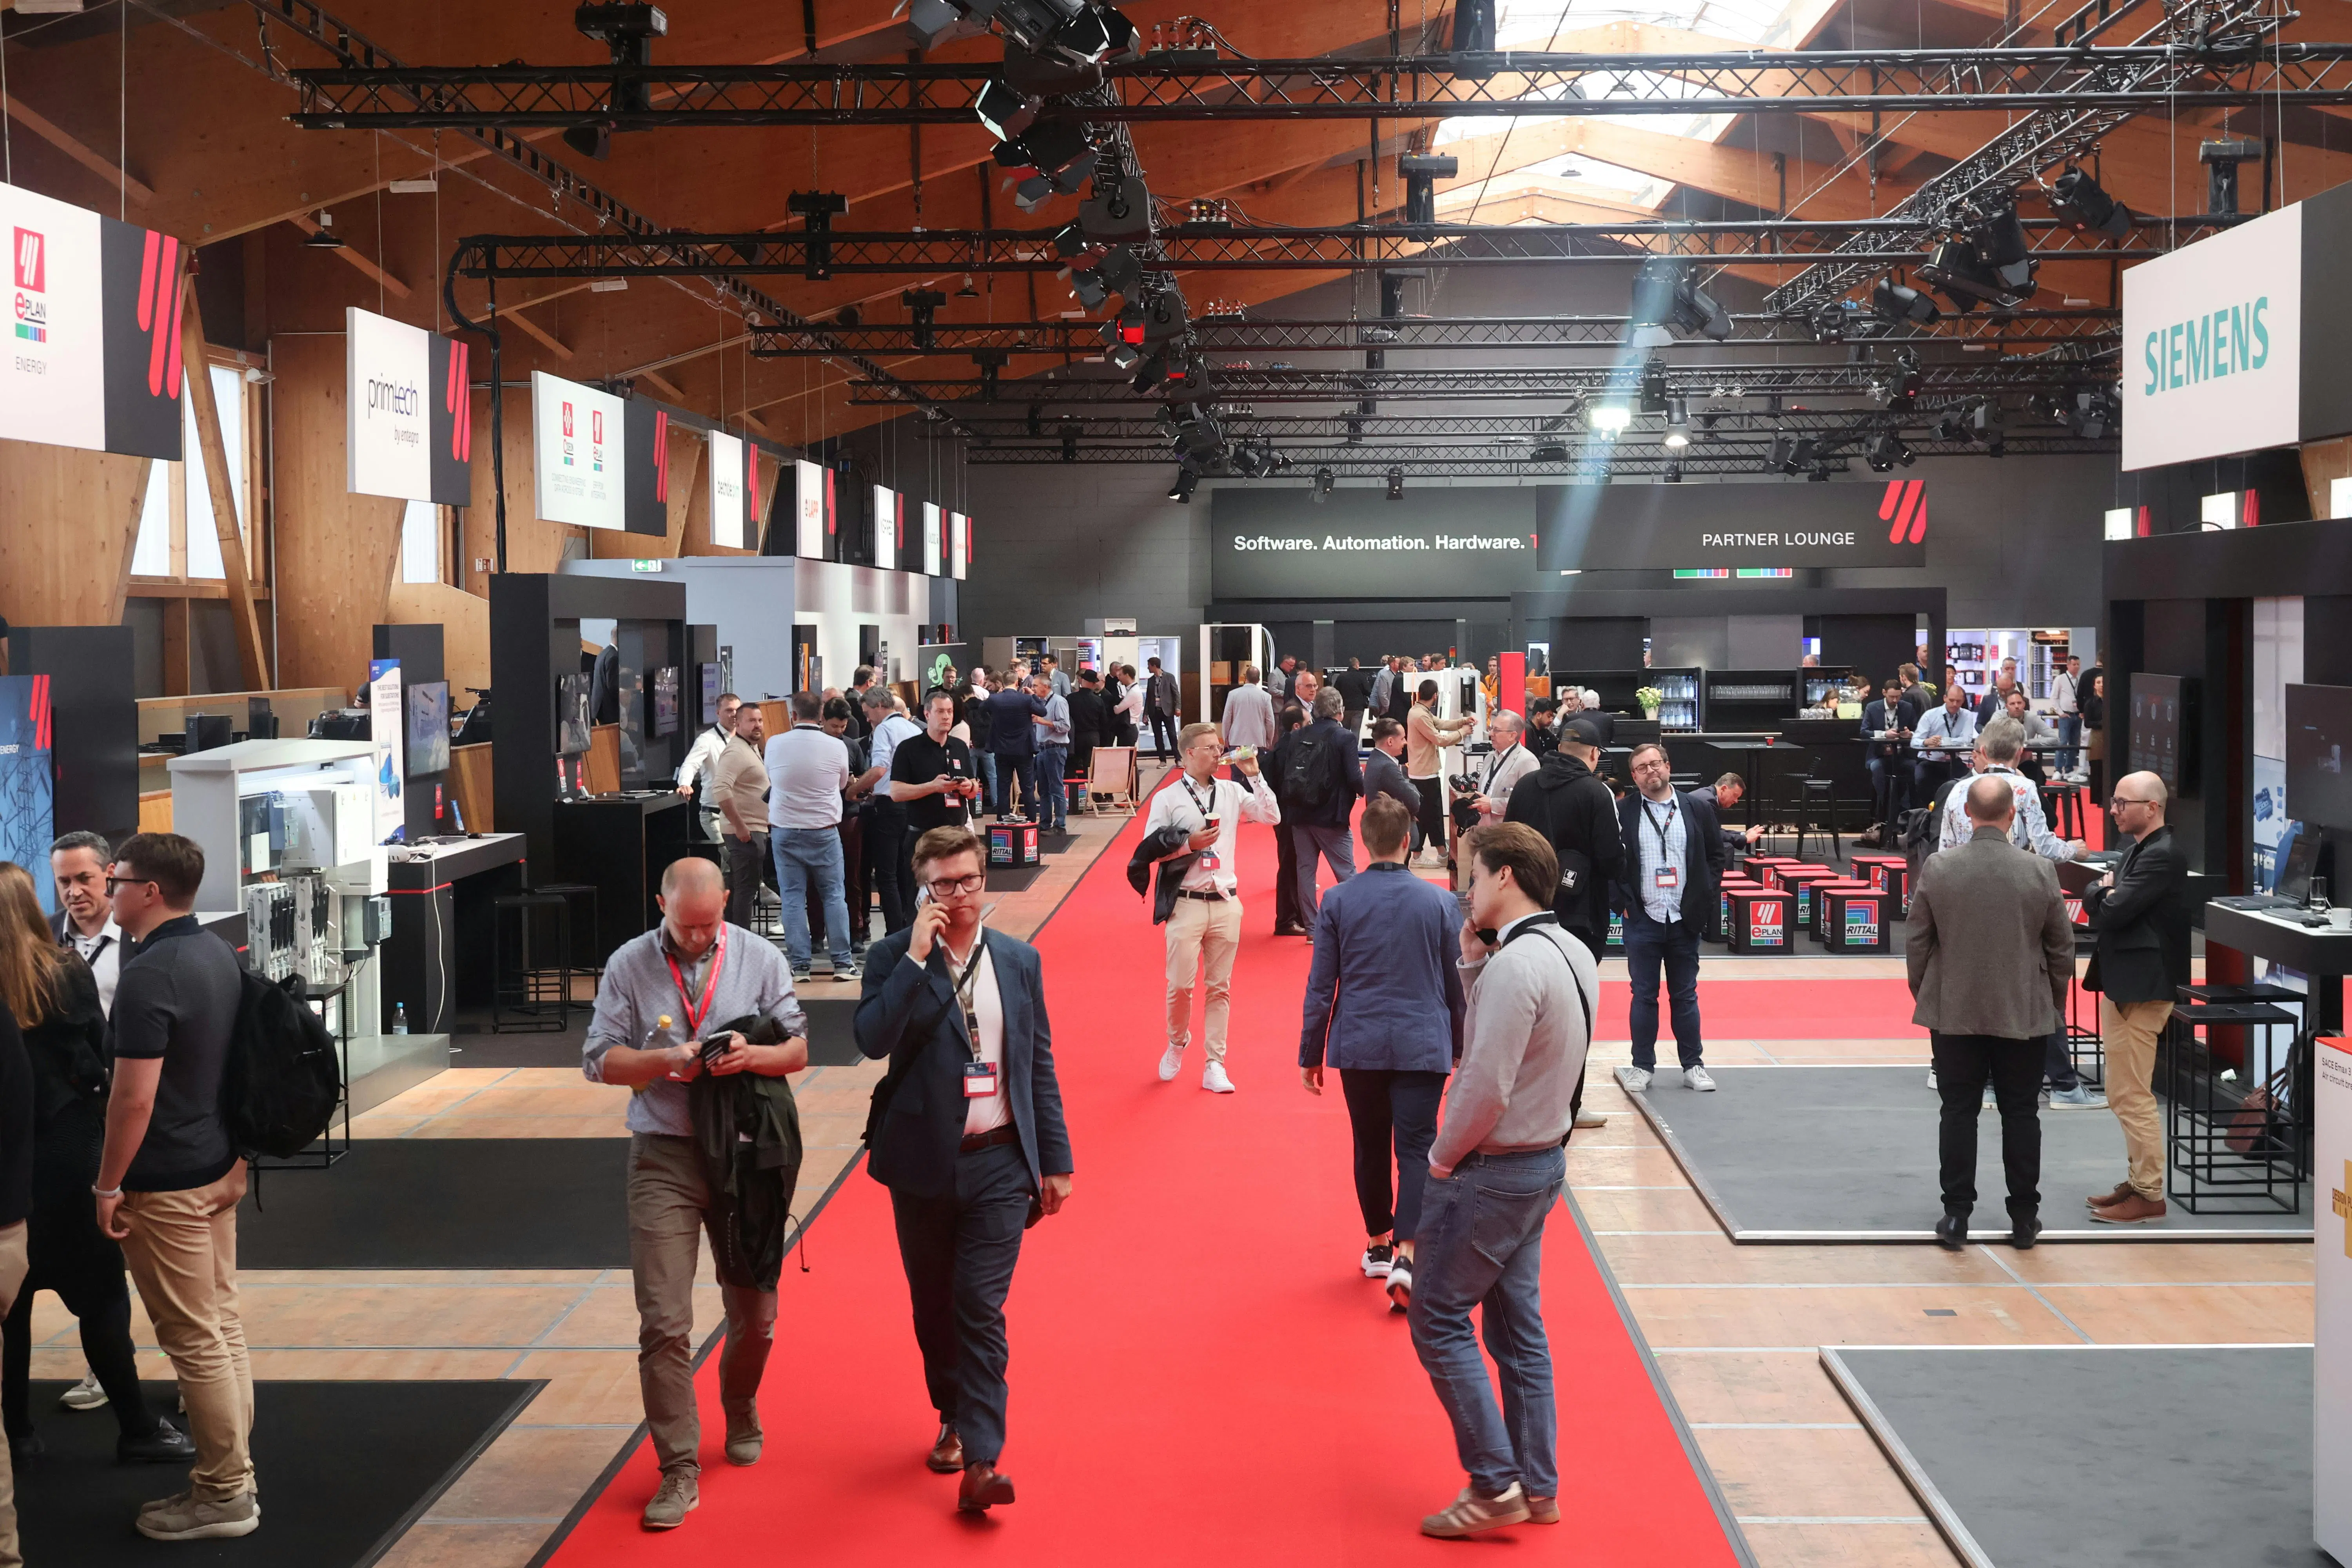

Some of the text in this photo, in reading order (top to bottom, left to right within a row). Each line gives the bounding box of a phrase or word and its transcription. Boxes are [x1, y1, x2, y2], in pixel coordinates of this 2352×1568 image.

[2145, 296, 2269, 396] SIEMENS
[16, 356, 47, 376] ENERGY
[368, 372, 417, 419] primtech
[394, 424, 419, 447] by entegra
[1234, 536, 1318, 551] Software.
[1322, 535, 1430, 550] Automation.
[1435, 534, 1525, 550] Hardware.
[1702, 532, 1855, 546] PARTNER LOUNGE
[1751, 927, 1782, 938] ePLAN
[1846, 926, 1877, 934] RITTAL
[2322, 1057, 2351, 1076] SACE Emax 3
[2330, 1074, 2345, 1087] circuit
[2332, 1187, 2346, 1205] DESIGN
